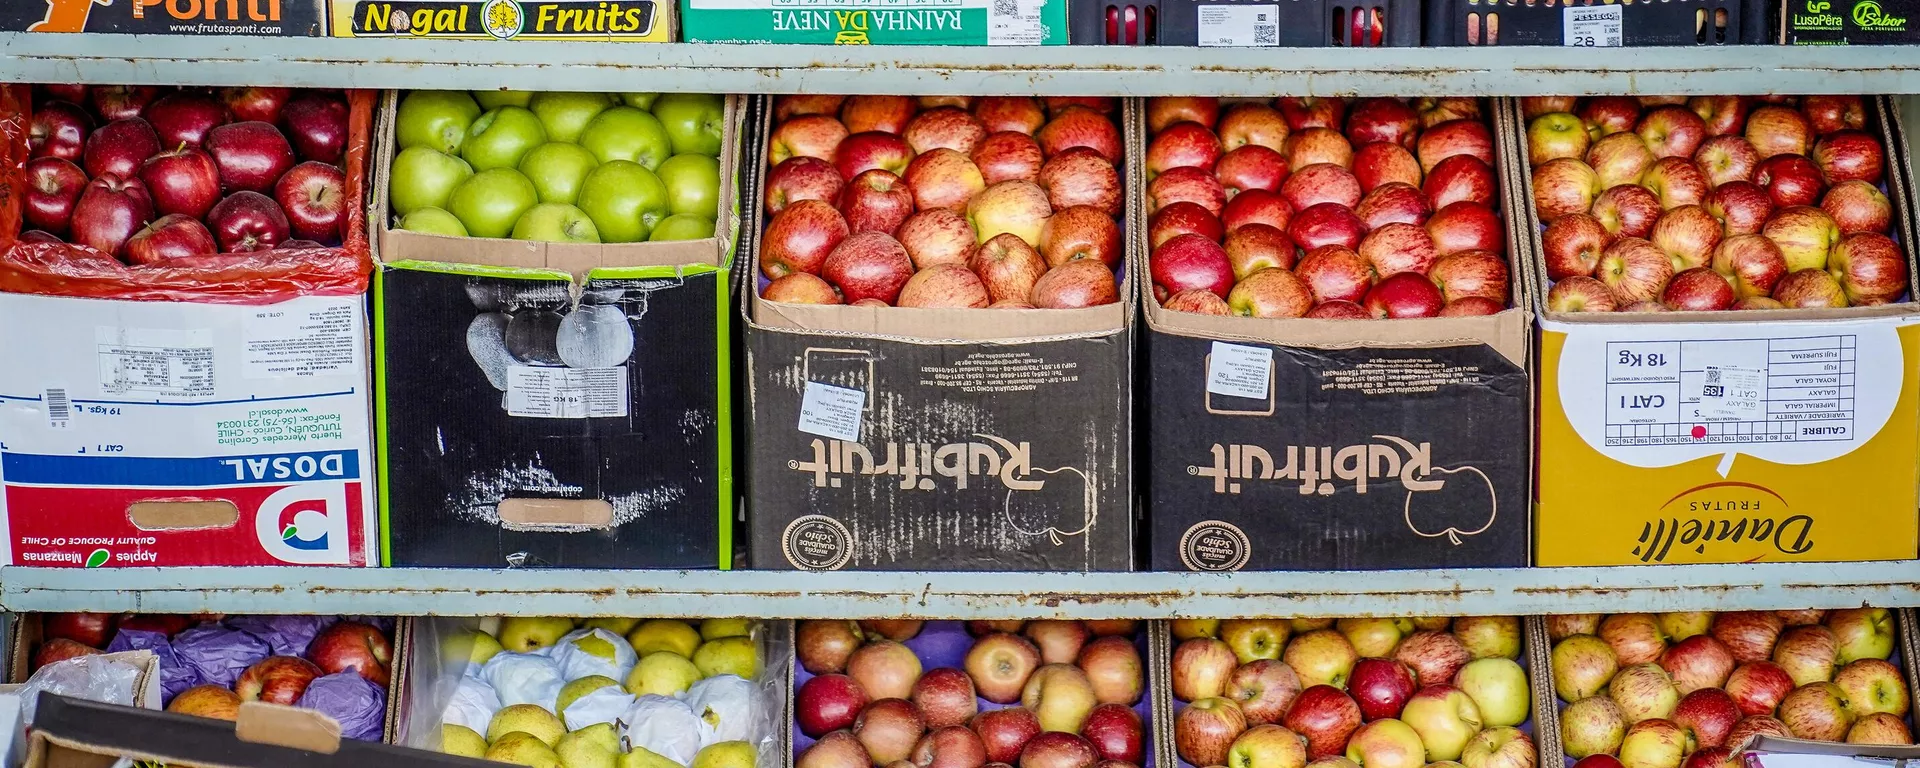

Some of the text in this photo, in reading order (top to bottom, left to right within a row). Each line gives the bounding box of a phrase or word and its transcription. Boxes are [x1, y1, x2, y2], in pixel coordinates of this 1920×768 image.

[536, 2, 642, 32] Fruits
[771, 10, 831, 31] NEVE
[833, 10, 868, 31] DA
[870, 10, 962, 31] RAINHA
[1794, 13, 1843, 26] LusoPêra
[1866, 13, 1907, 27] Sabor
[169, 23, 282, 34] www.frutasponti.com
[1573, 36, 1595, 46] 28
[1618, 350, 1667, 367] 18 Kg
[1703, 386, 1724, 397] 135
[1620, 395, 1665, 408] CAT I
[88, 406, 121, 415] 19 kgs.
[248, 407, 308, 419] www.dosal.cl
[217, 413, 341, 429] FonoFax: (56-75) 2310034
[218, 429, 244, 438] CHILE
[252, 427, 284, 435] Curicó
[285, 423, 342, 434] TUTUQUÉN,
[1802, 427, 1846, 435] CALIBRE
[218, 431, 342, 446] Huerto Mercedes Carolina
[105, 444, 123, 452] CAT
[226, 453, 344, 480] DOSAL
[1690, 501, 1760, 512] FRUTAS
[22, 536, 156, 546] QUALITY PRODUCE OF CHILE
[805, 532, 834, 543] Schio
[1203, 537, 1232, 548] Schio
[1631, 515, 1814, 562] Danielli
[799, 540, 836, 550] QUALIDADE
[1196, 545, 1234, 555] QUALIDADE
[22, 550, 158, 564] Apples Manzanas
